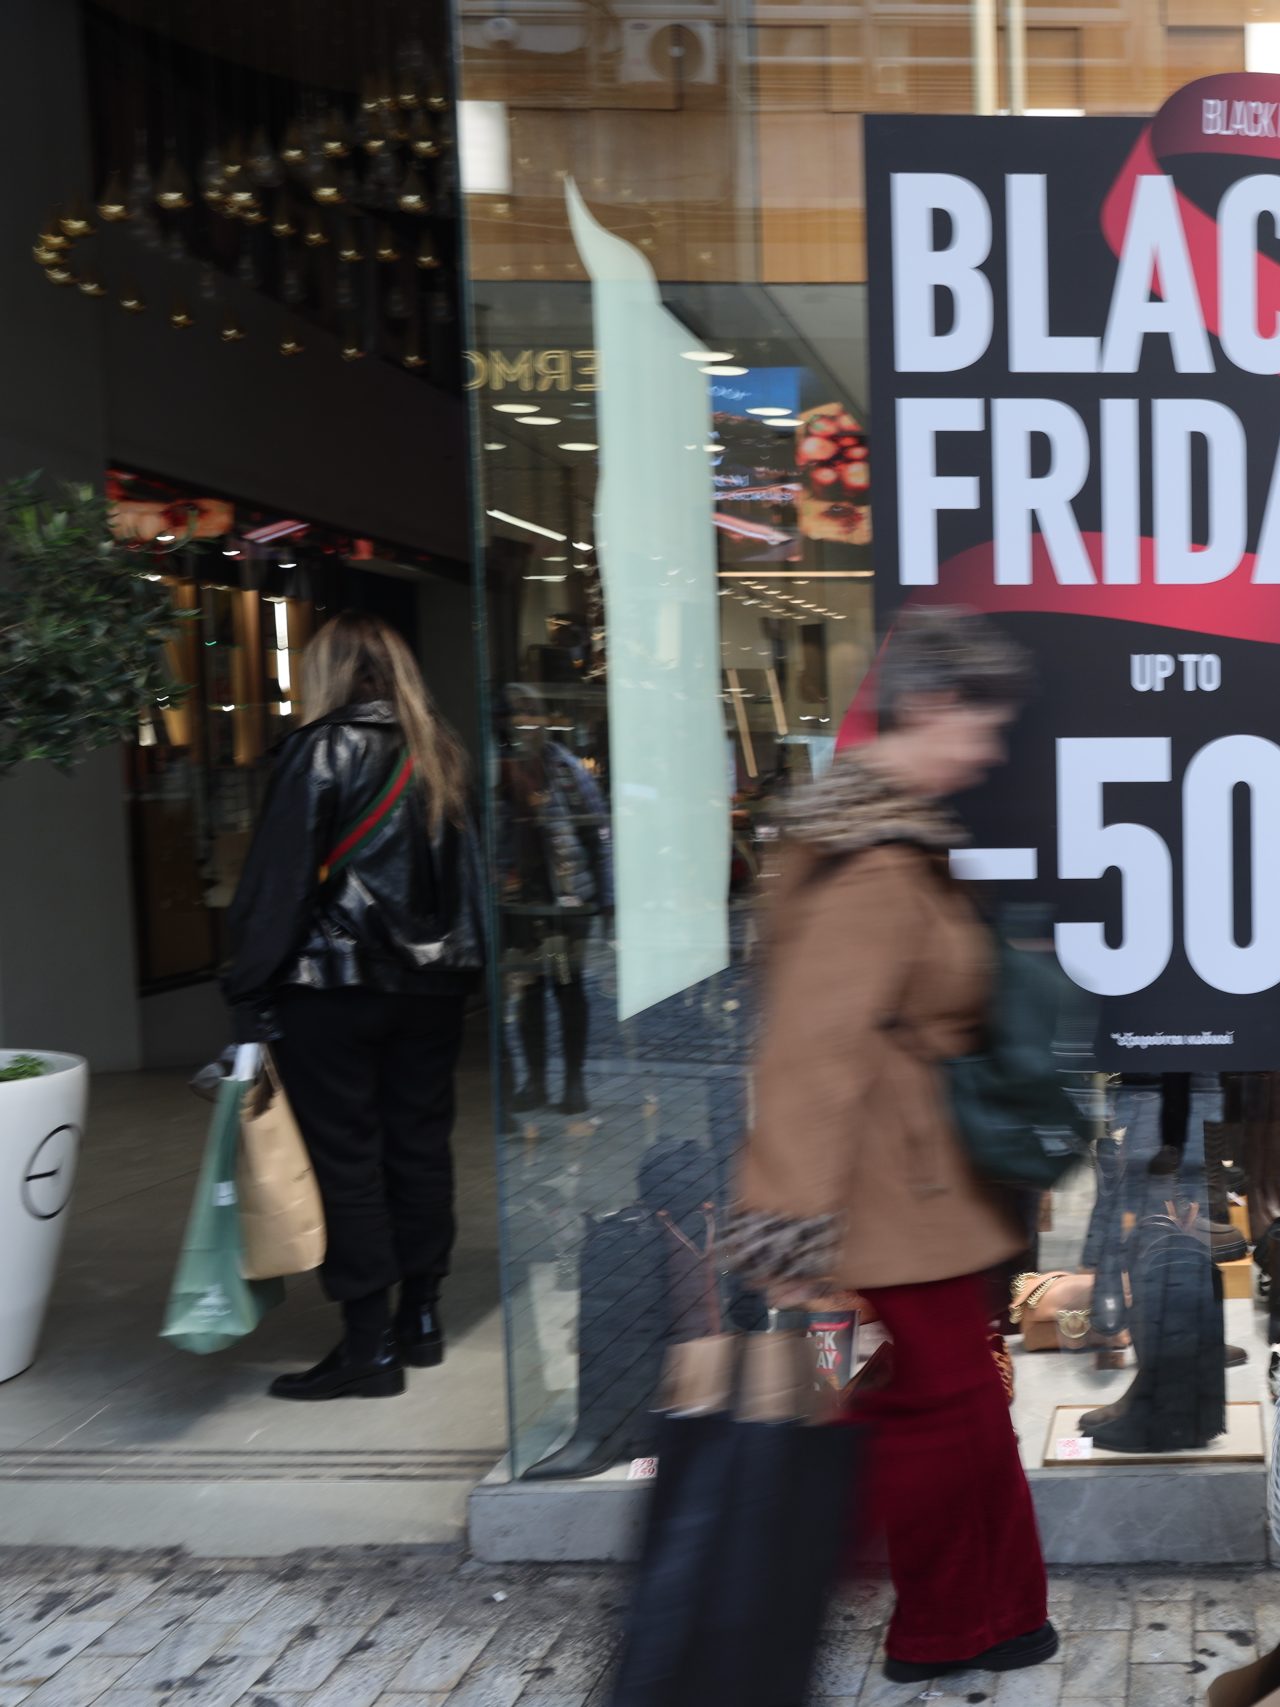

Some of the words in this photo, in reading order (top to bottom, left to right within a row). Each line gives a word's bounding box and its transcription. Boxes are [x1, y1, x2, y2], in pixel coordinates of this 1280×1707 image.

[1202, 99, 1277, 137] BLACK
[1131, 653, 1176, 692] UP
[1177, 653, 1222, 692] TO
